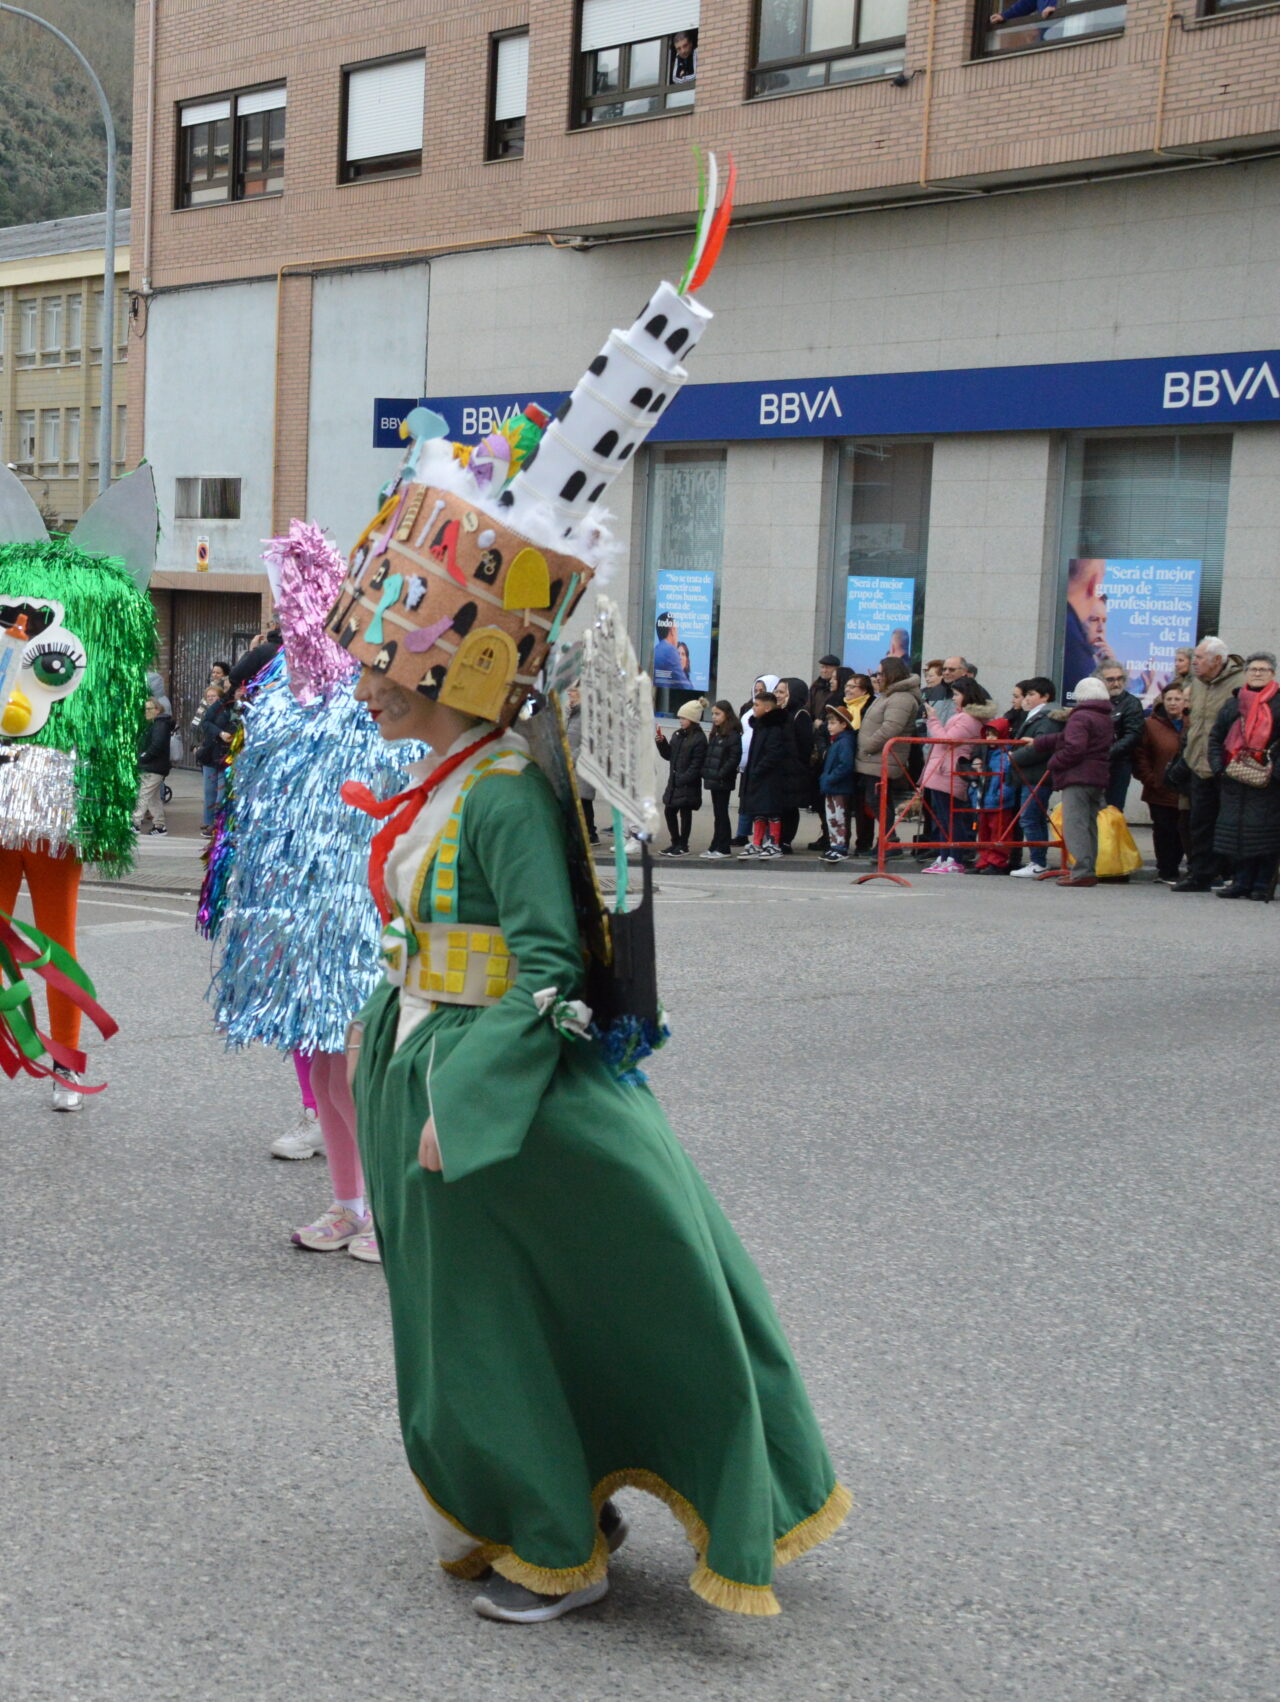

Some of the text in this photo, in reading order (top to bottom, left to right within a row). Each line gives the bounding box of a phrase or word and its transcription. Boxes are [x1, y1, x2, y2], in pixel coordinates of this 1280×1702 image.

[1163, 361, 1280, 408] BBVA
[760, 386, 842, 425] BBVA
[1142, 566, 1154, 580] el
[1156, 567, 1196, 583] mejor
[1095, 583, 1133, 597] grupo
[1136, 581, 1152, 595] de
[1106, 596, 1192, 612] profesionales
[657, 619, 673, 627] todo
[1129, 611, 1192, 628] del sector
[1160, 628, 1175, 642] de
[1178, 628, 1190, 642] la
